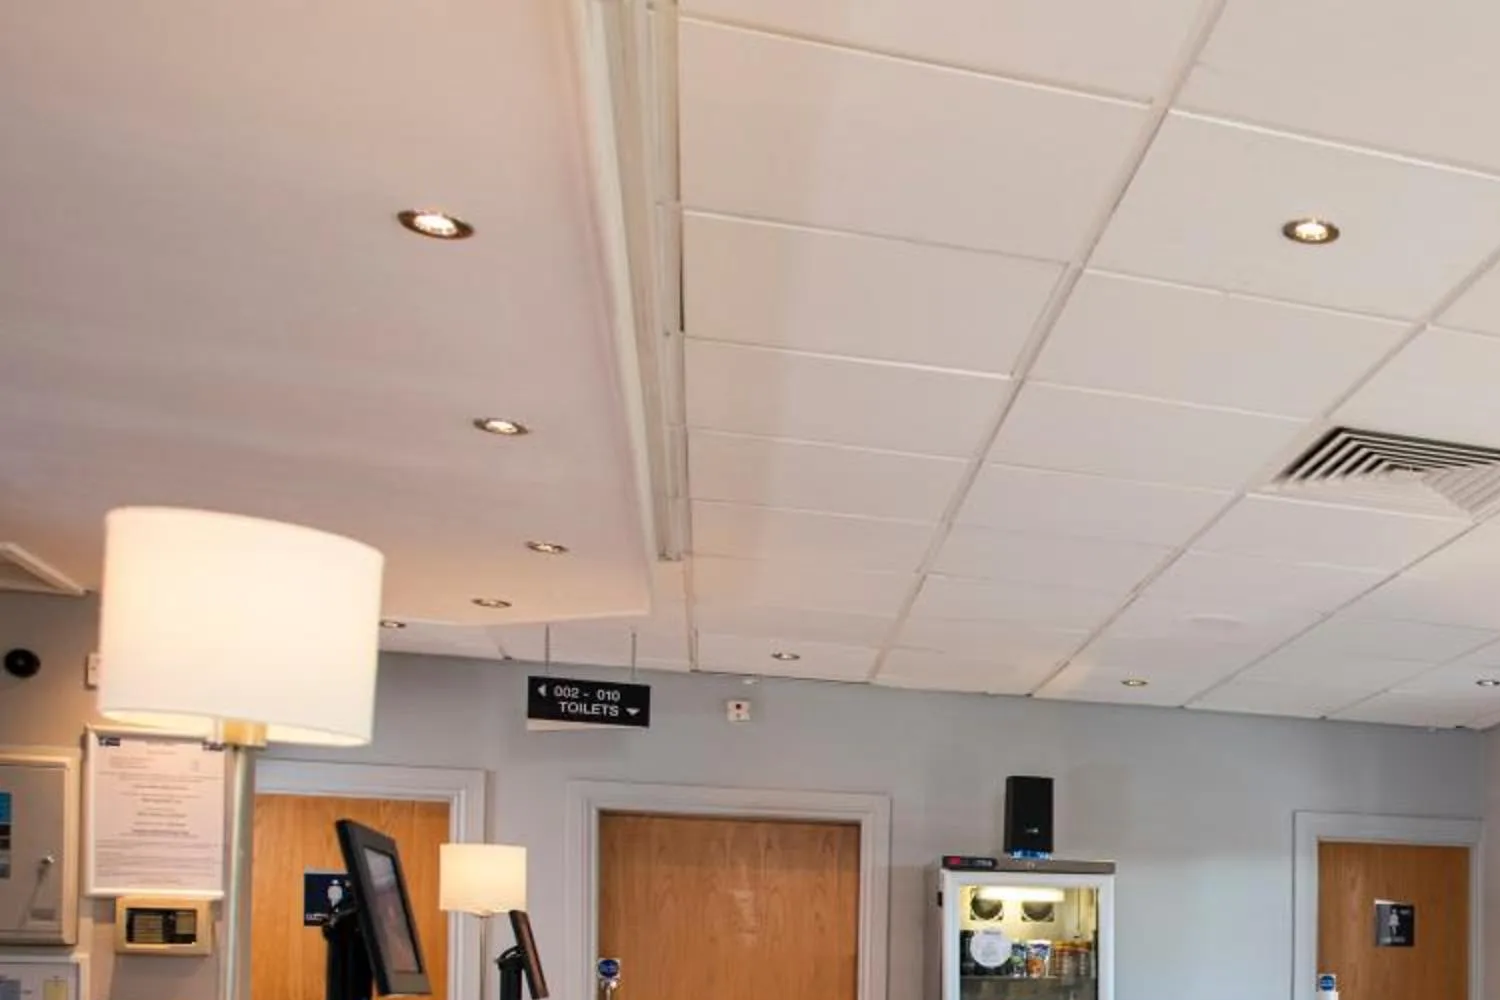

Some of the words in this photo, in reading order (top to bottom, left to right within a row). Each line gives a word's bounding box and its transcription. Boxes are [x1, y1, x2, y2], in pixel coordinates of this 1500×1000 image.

[554, 685, 579, 698] 002
[597, 689, 620, 701] 010
[559, 701, 619, 716] TOILETS
